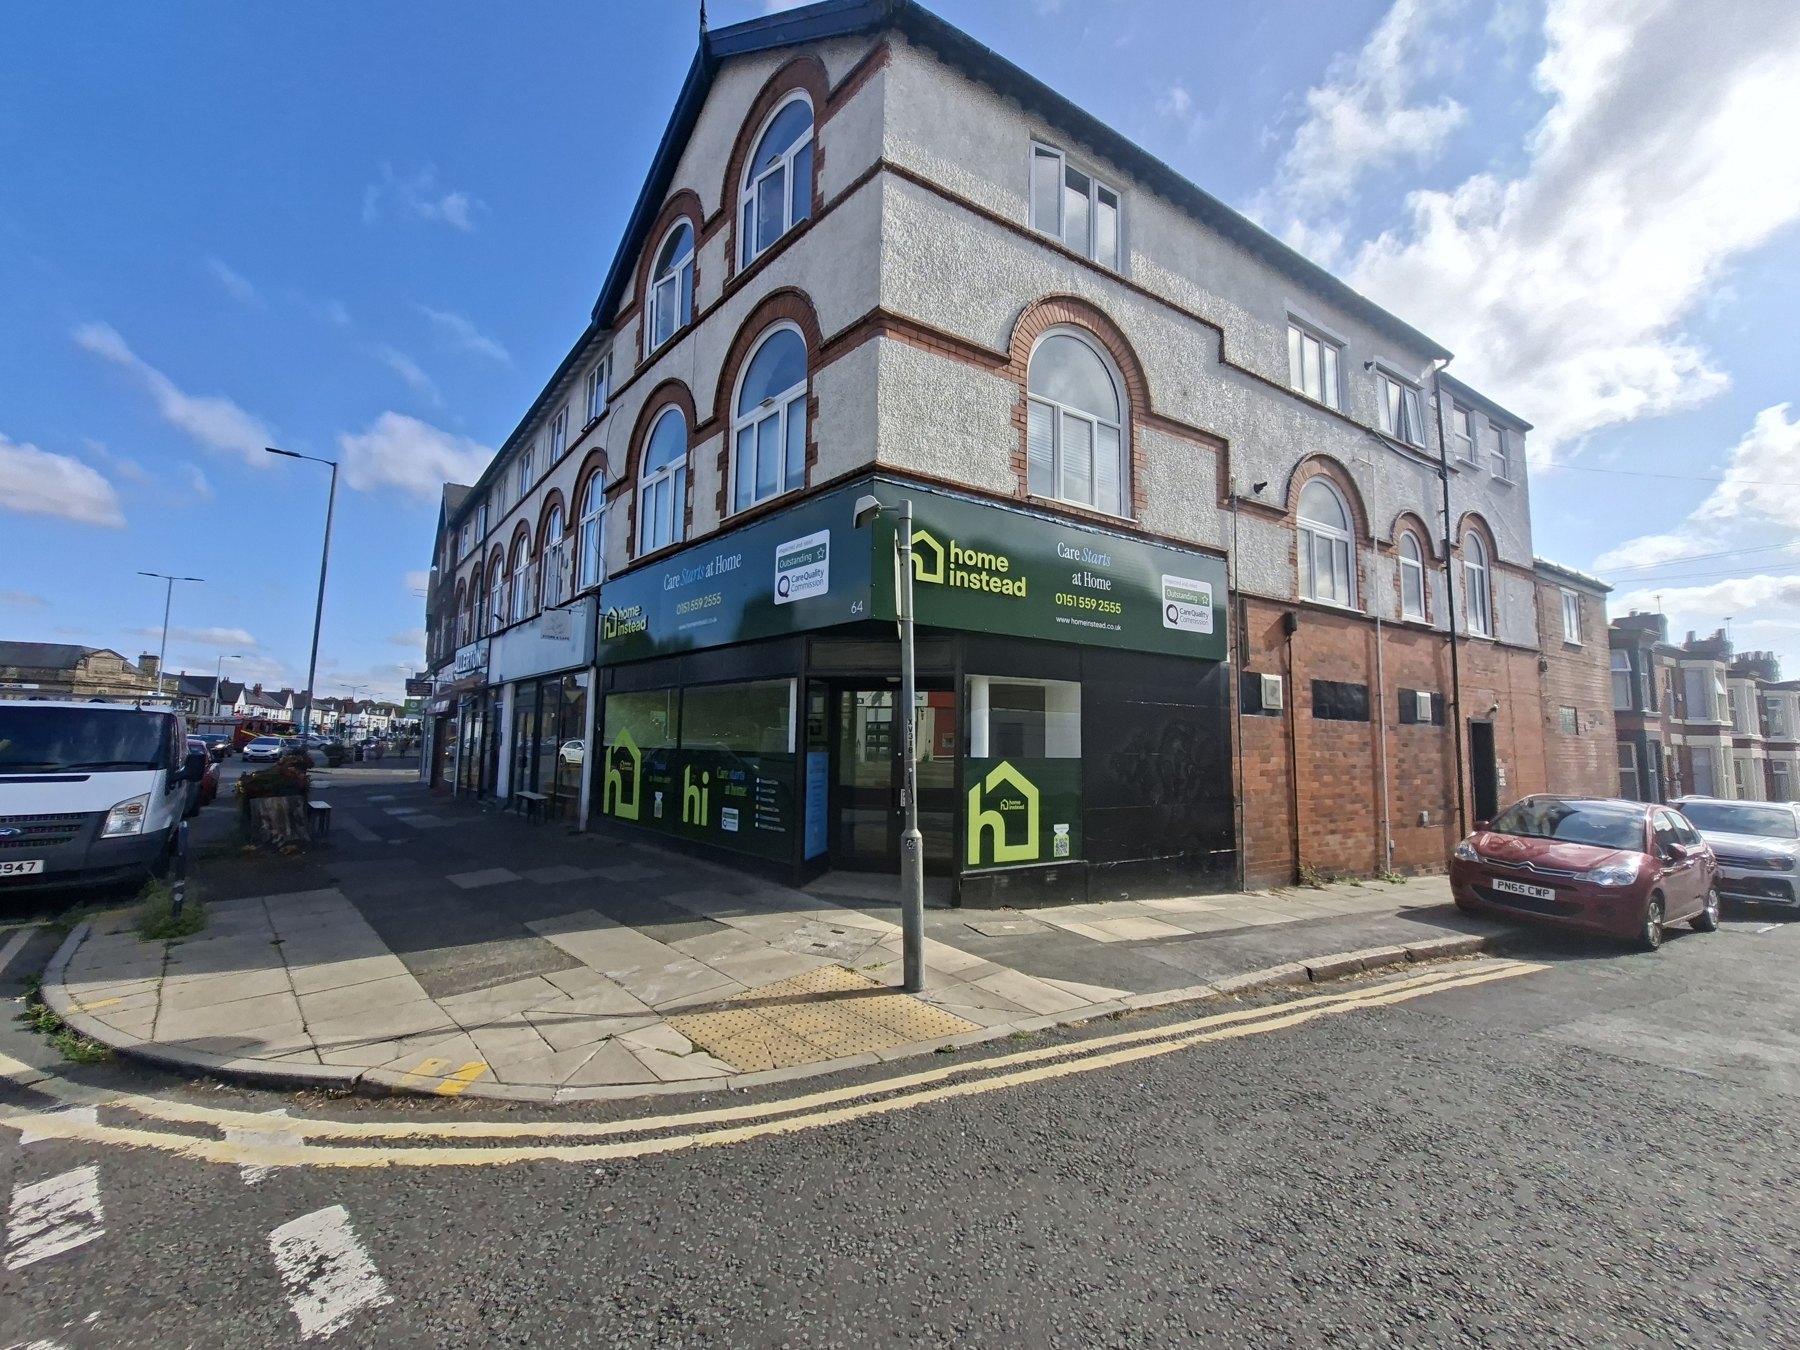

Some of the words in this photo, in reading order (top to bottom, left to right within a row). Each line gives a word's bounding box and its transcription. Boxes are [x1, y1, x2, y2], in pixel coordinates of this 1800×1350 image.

[779, 553, 813, 568] Outstanding
[950, 539, 1009, 573] home
[1057, 541, 1080, 561] Care
[1081, 547, 1111, 567] Starts
[663, 573, 680, 591] Care
[680, 564, 705, 586] Starts
[705, 560, 714, 578] at
[715, 553, 742, 575] Home
[949, 563, 1027, 598] instead
[1071, 572, 1082, 586] at
[1083, 571, 1112, 591] Home
[790, 579, 824, 593] Commission
[676, 601, 690, 615] 0151
[690, 597, 703, 611] 559
[703, 591, 722, 608] 2555
[1055, 592, 1077, 607] 0151
[1078, 596, 1097, 610] 559
[1098, 600, 1122, 614] 2555
[1166, 589, 1198, 604] Outstanding
[618, 605, 641, 620] home
[851, 600, 863, 614] 64
[617, 615, 647, 637] instead
[1180, 615, 1209, 626] Commission
[682, 764, 710, 827] hi
[0, 861, 36, 874] 947
[1497, 880, 1525, 894] PN65
[1527, 886, 1550, 897] CWP
